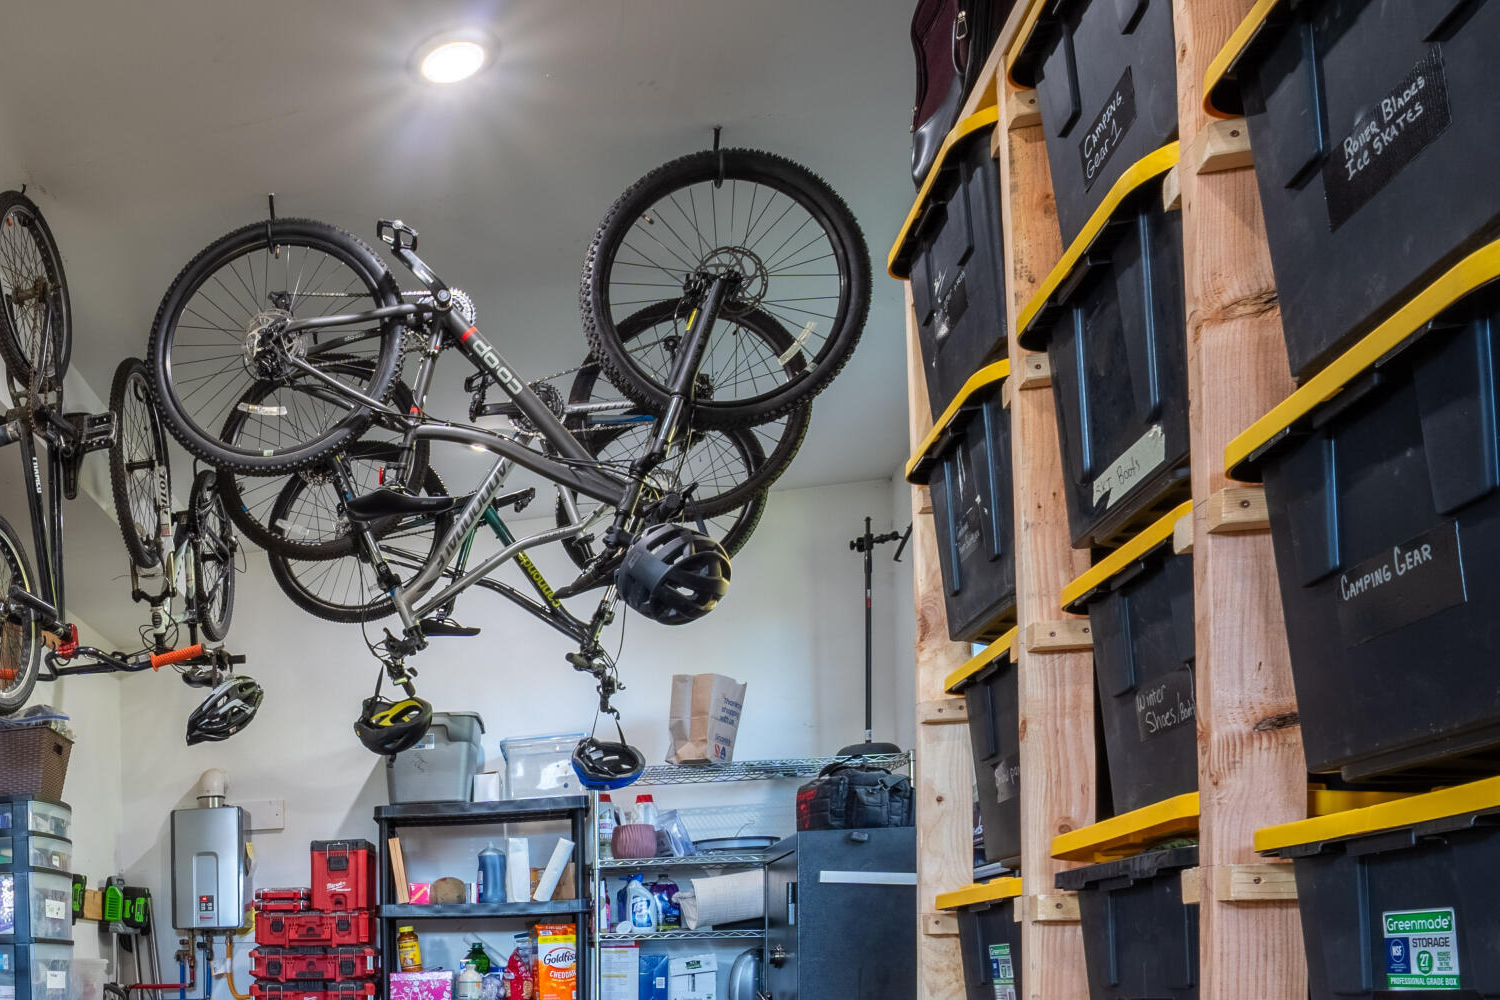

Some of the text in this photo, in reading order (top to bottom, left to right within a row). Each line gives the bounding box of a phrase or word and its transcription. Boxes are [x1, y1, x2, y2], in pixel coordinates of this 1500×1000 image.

[1086, 118, 1122, 179] Gear 1
[1116, 456, 1140, 484] Boots
[437, 460, 511, 571] ANNONDALE
[1341, 544, 1432, 600] CAMPING GEAR
[1412, 936, 1450, 948] STORAGE
[1419, 953, 1429, 967] 27
[1390, 976, 1457, 986] PROFESSIONAL GRADE BOX
